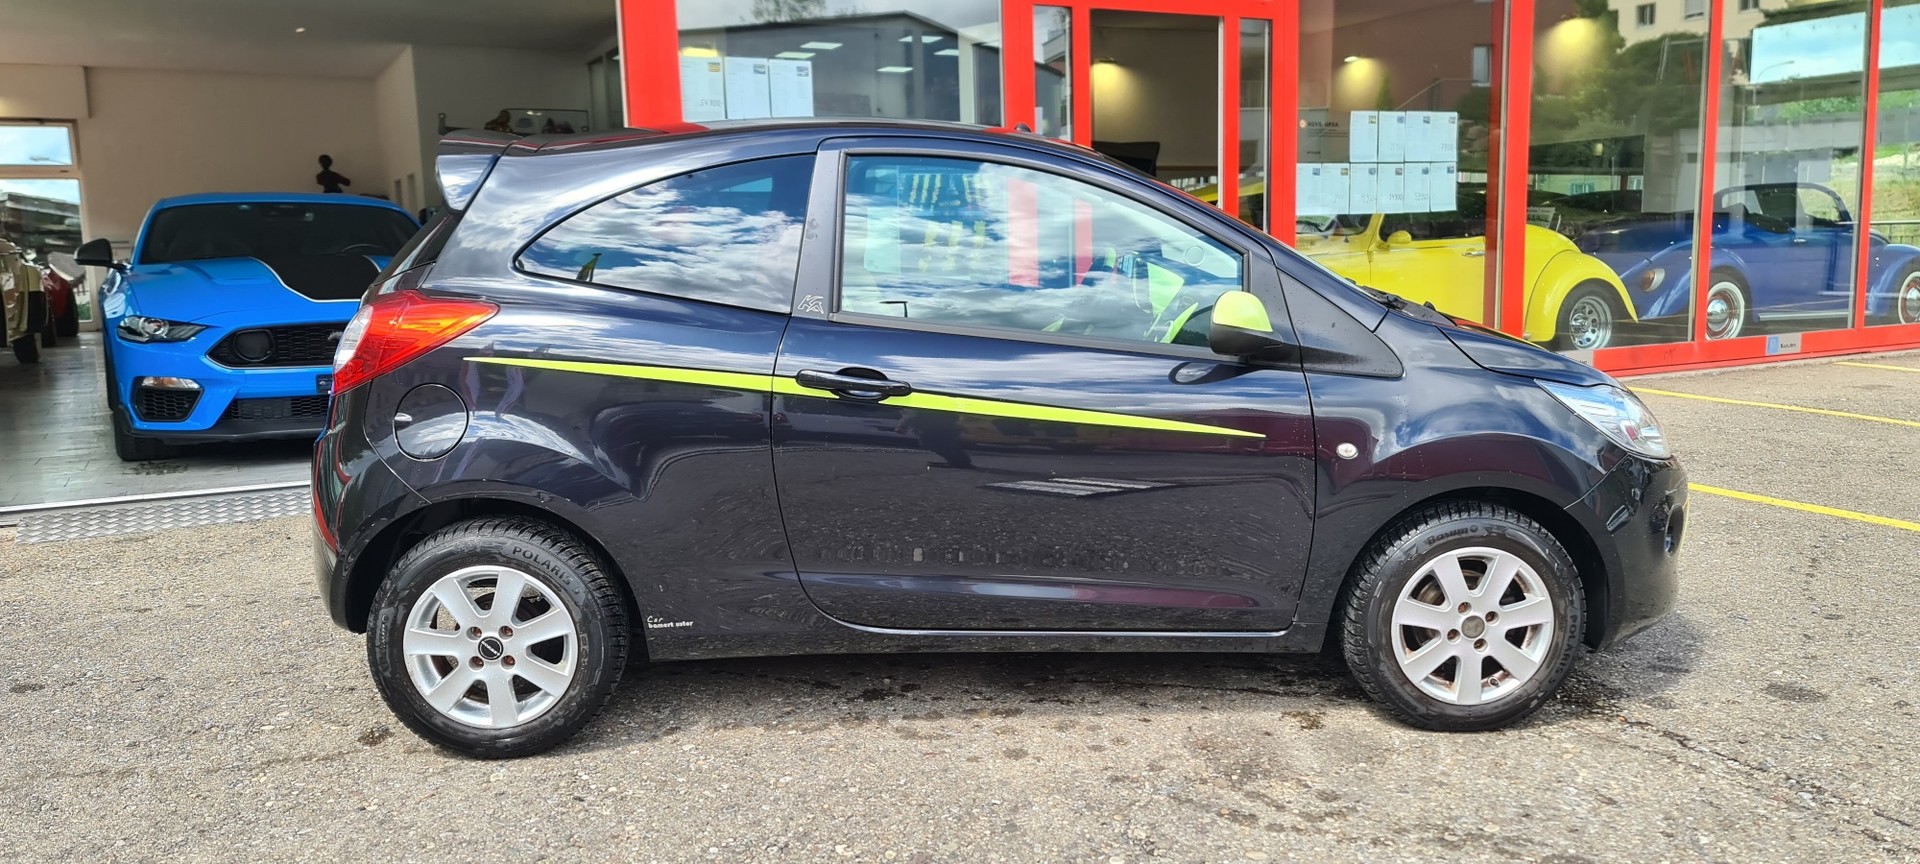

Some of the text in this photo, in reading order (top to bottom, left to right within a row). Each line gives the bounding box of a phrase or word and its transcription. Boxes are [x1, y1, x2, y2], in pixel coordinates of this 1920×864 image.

[1423, 527, 1469, 546] Barum
[512, 546, 573, 586] POLARIS
[1555, 614, 1578, 674] POLARIS
